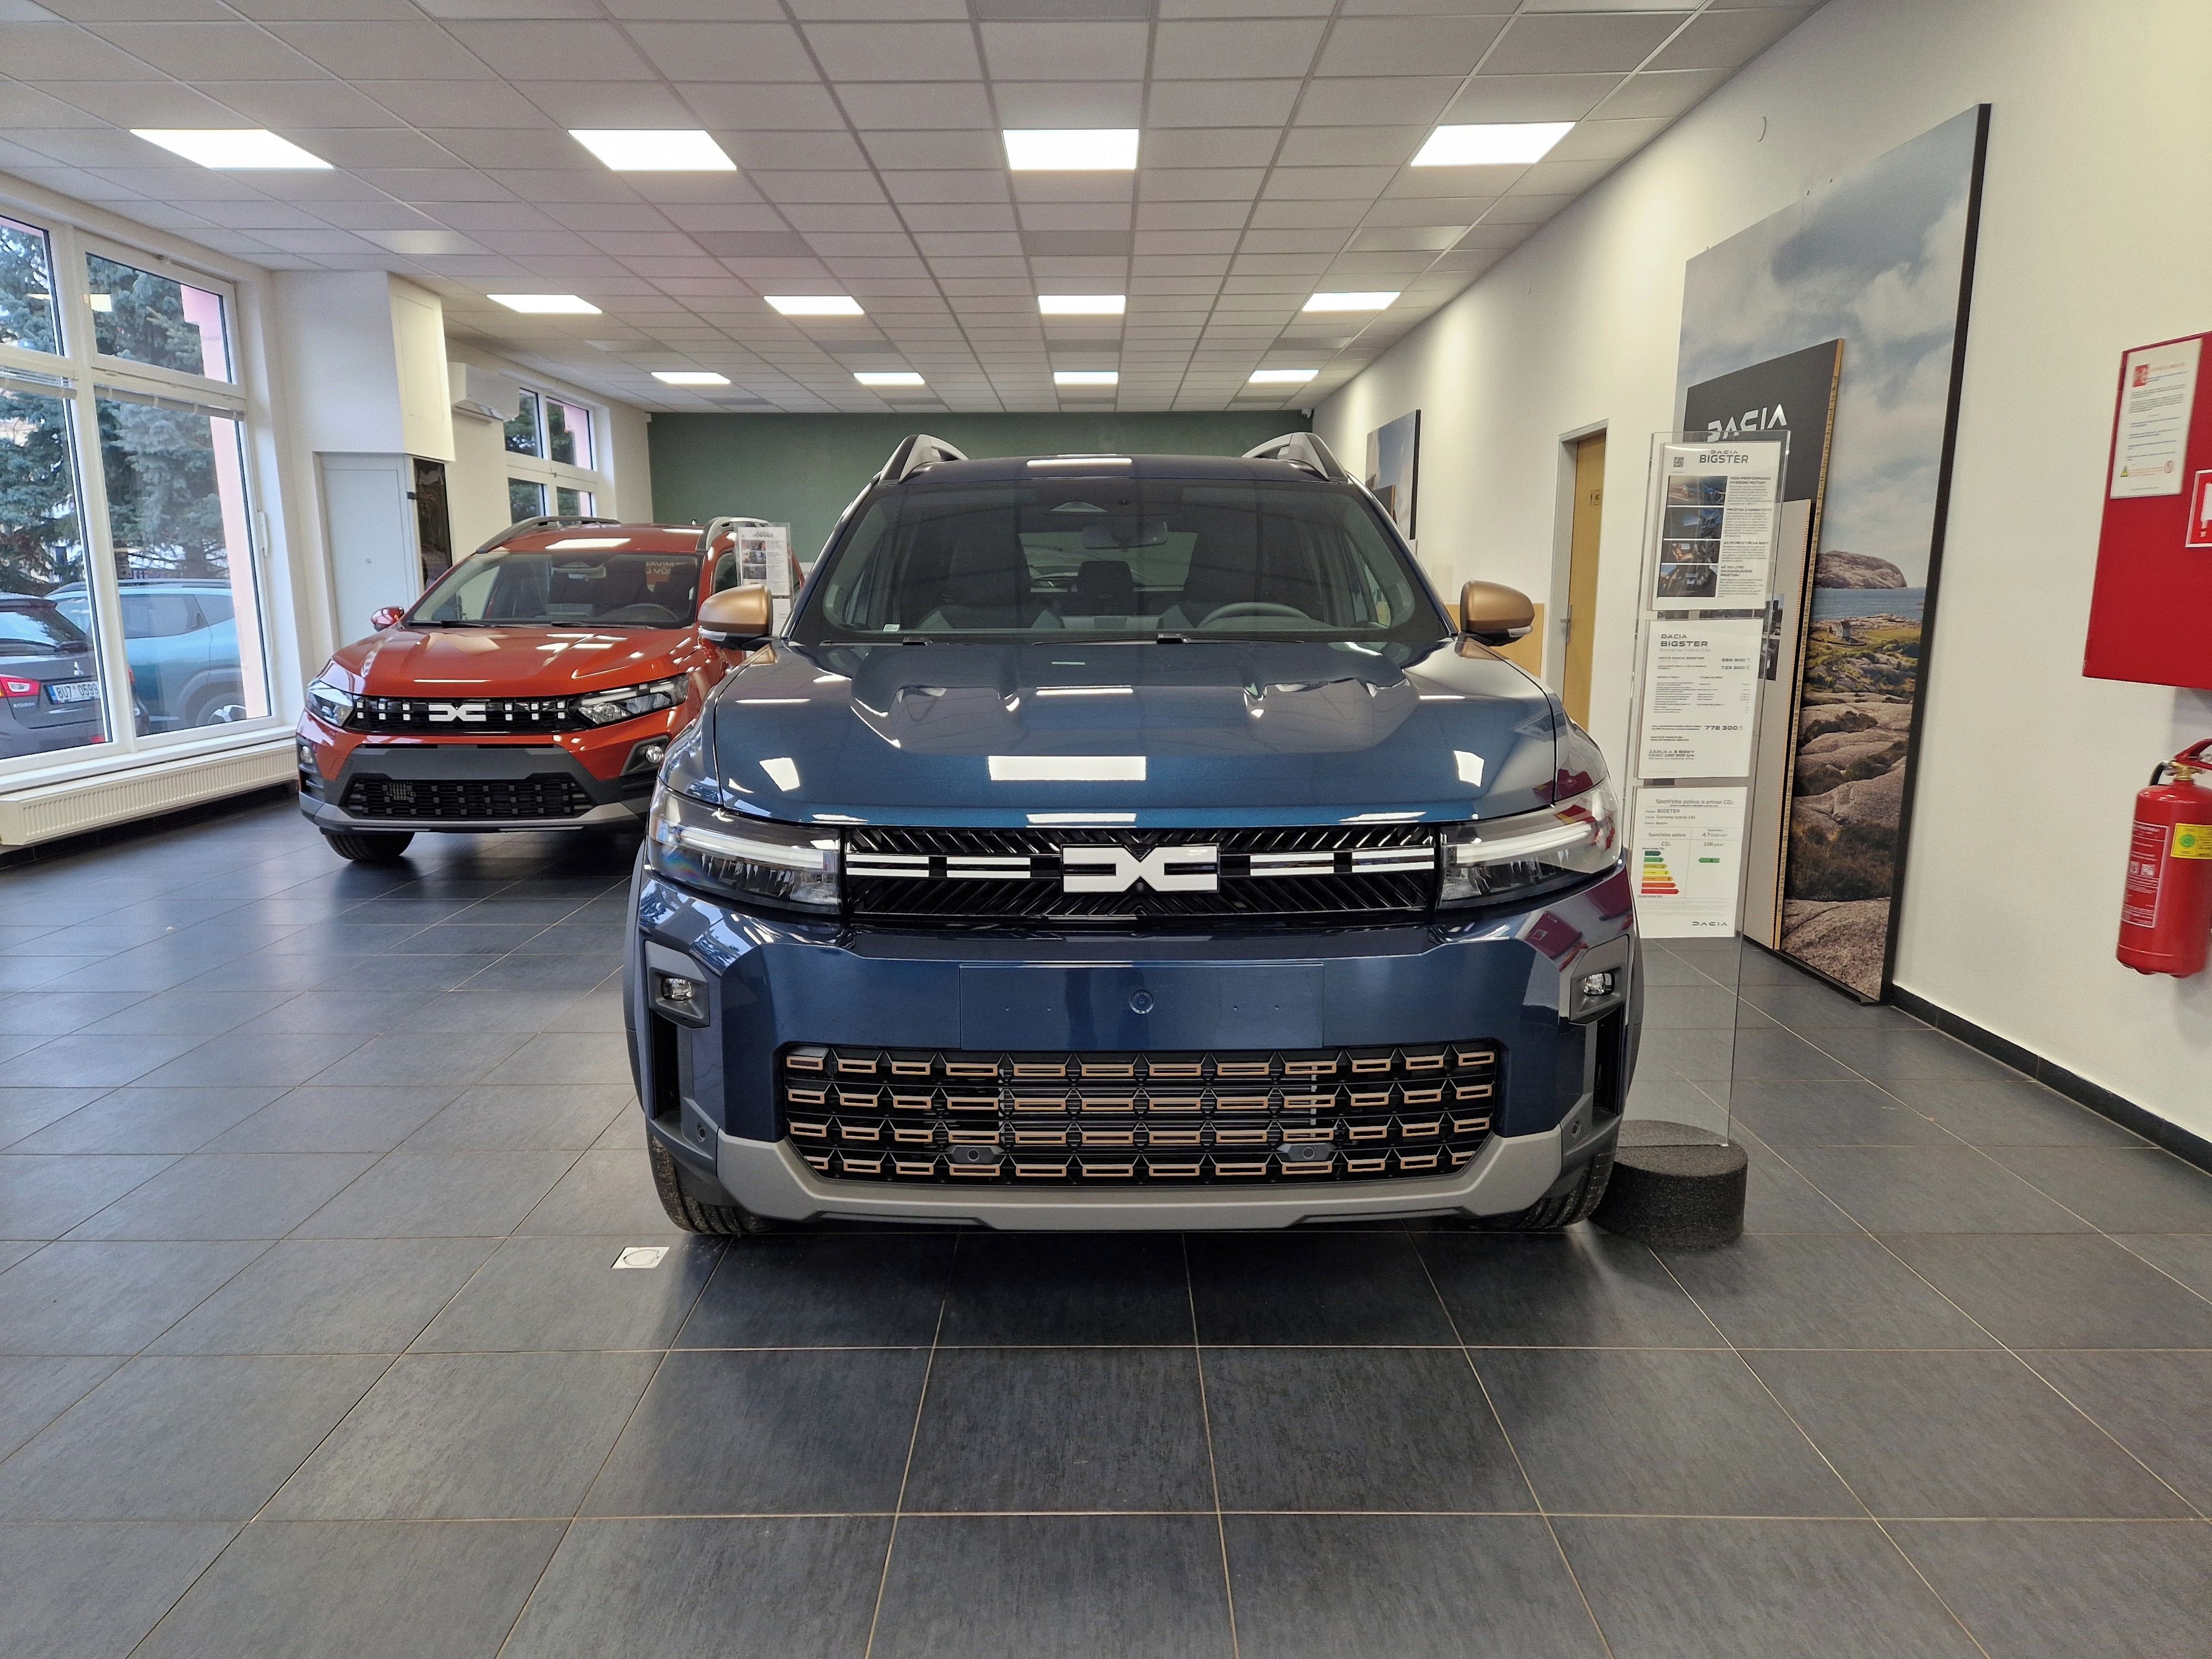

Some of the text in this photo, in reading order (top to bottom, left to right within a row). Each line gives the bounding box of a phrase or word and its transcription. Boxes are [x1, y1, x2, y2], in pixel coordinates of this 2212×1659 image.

[1707, 403, 1787, 442] DACIA
[1699, 455, 1749, 463] BIGSTER
[56, 683, 99, 699] 8U7 0599
